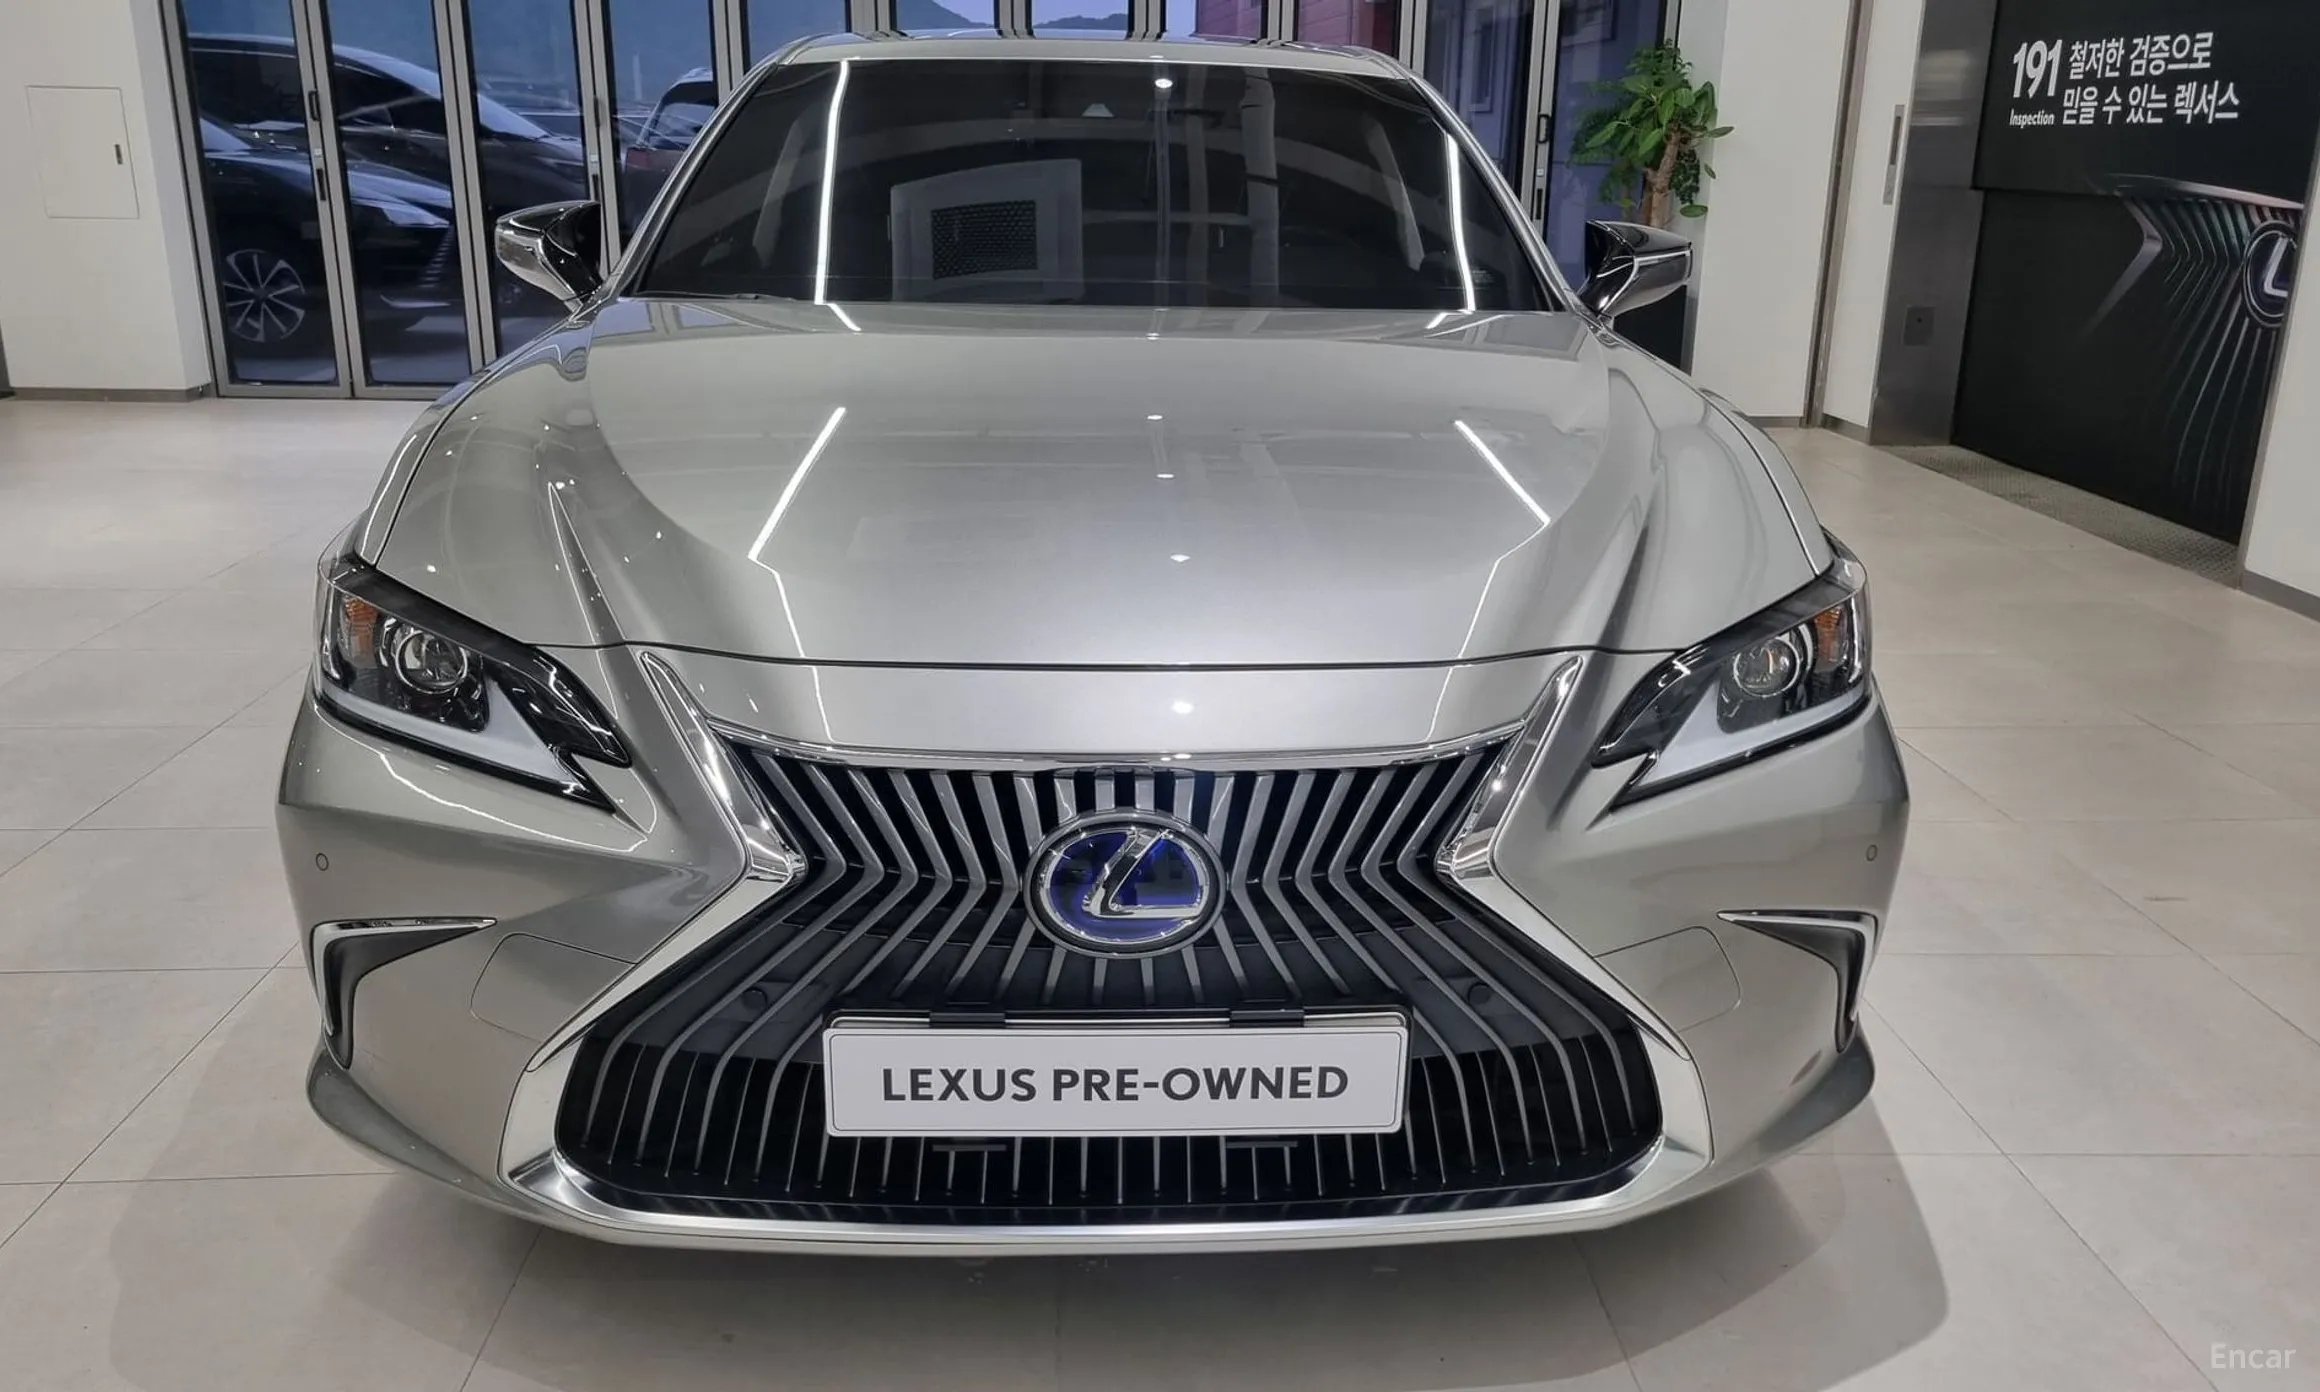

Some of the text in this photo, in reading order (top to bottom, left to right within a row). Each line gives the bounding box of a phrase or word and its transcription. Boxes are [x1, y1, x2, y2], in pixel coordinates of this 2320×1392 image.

[2013, 39, 2063, 98] 191
[2069, 32, 2213, 80] 철저한 검증으로
[2009, 108, 2055, 128] Inspection
[2062, 80, 2240, 125] 믿을 수 있는 렉서스
[882, 1066, 1349, 1102] LEXUS PRE-OWNED
